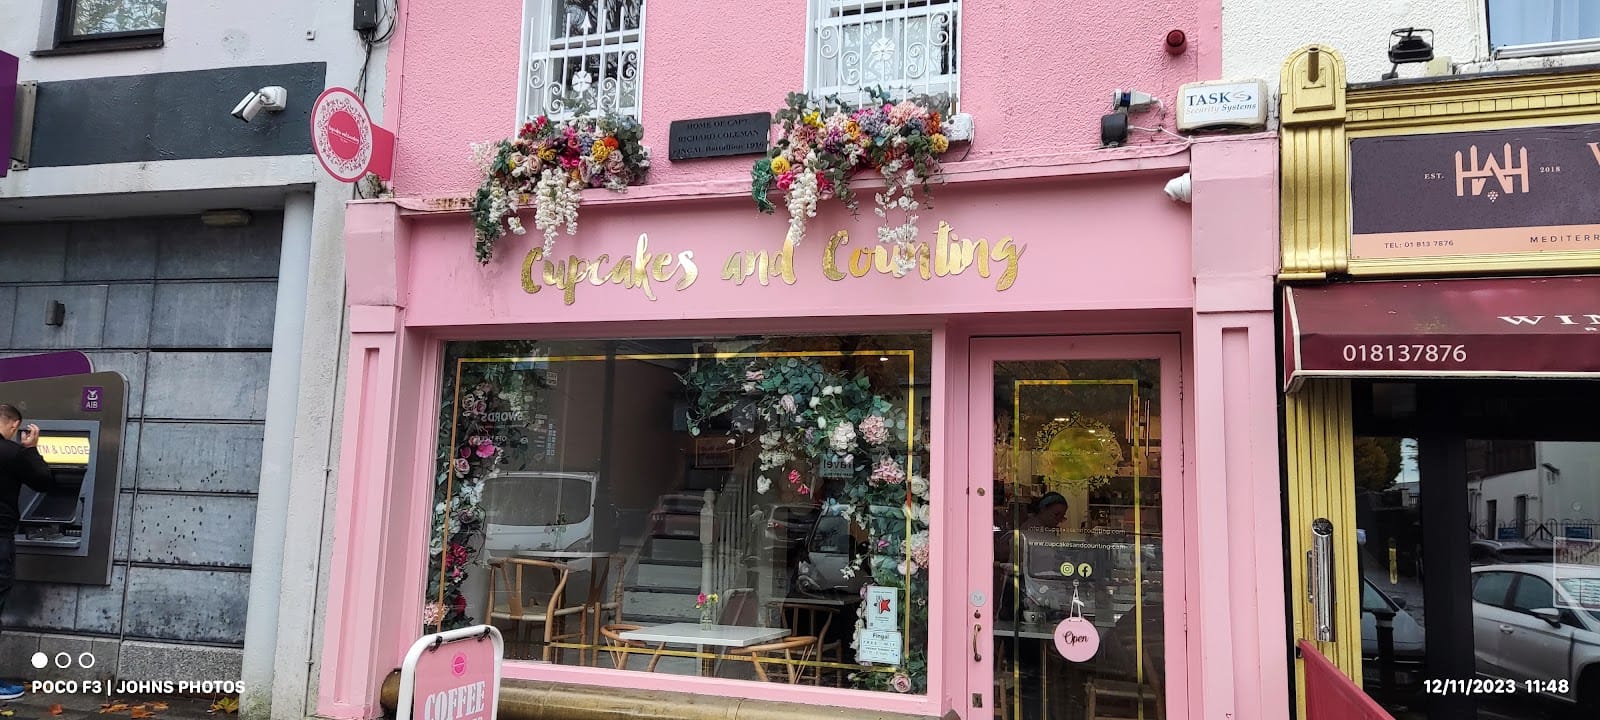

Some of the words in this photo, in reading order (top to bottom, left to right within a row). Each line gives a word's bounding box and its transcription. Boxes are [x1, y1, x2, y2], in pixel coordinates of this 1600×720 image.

[1187, 92, 1231, 106] TASK
[1186, 105, 1219, 115] Security
[1221, 103, 1257, 112] Systems
[687, 122, 711, 130] HOME
[713, 120, 724, 128] OF
[678, 132, 716, 143] RICHARD
[521, 232, 699, 305] Cupcakes
[720, 225, 797, 286] and
[823, 219, 1027, 292] Counting
[1343, 344, 1467, 362] 018137876
[86, 401, 98, 409] AIB
[38, 444, 50, 454] TM
[60, 445, 90, 455] LODGE
[1063, 630, 1088, 646] Open
[424, 680, 486, 720] COFFEE
